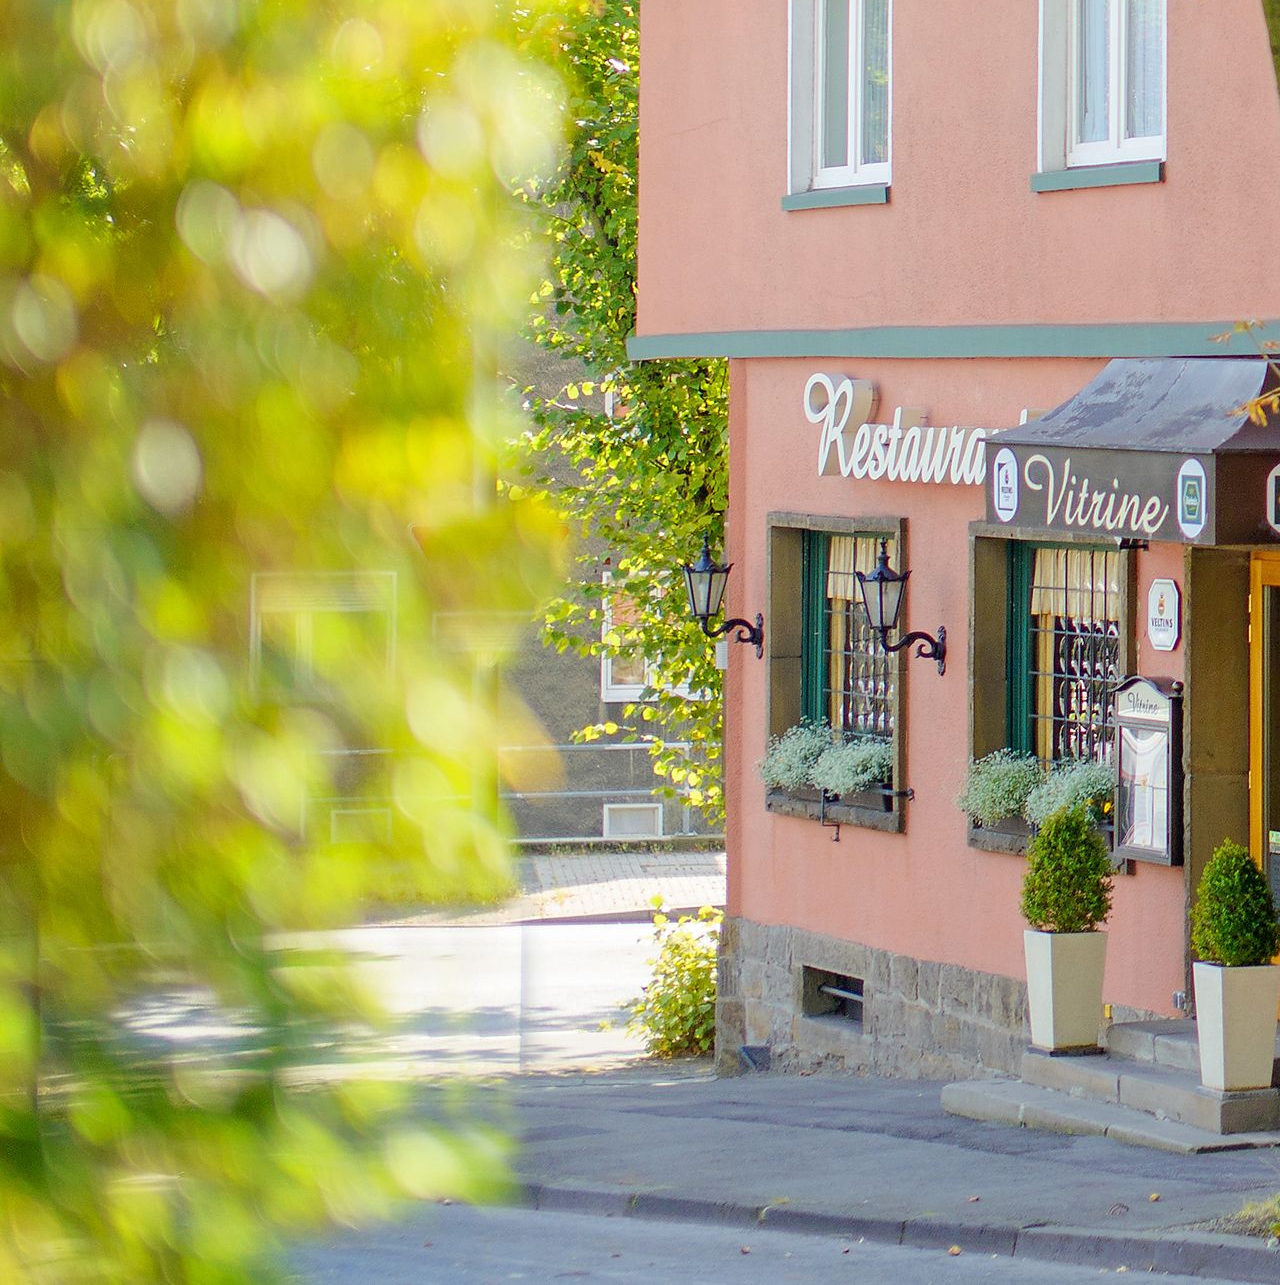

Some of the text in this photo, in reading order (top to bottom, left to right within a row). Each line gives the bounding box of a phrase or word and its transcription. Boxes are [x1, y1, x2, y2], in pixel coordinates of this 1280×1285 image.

[804, 372, 1008, 485] Restaura
[1024, 454, 1169, 533] Vitrine
[1152, 618, 1173, 628] VELTINS
[1128, 692, 1160, 715] Vitrine
